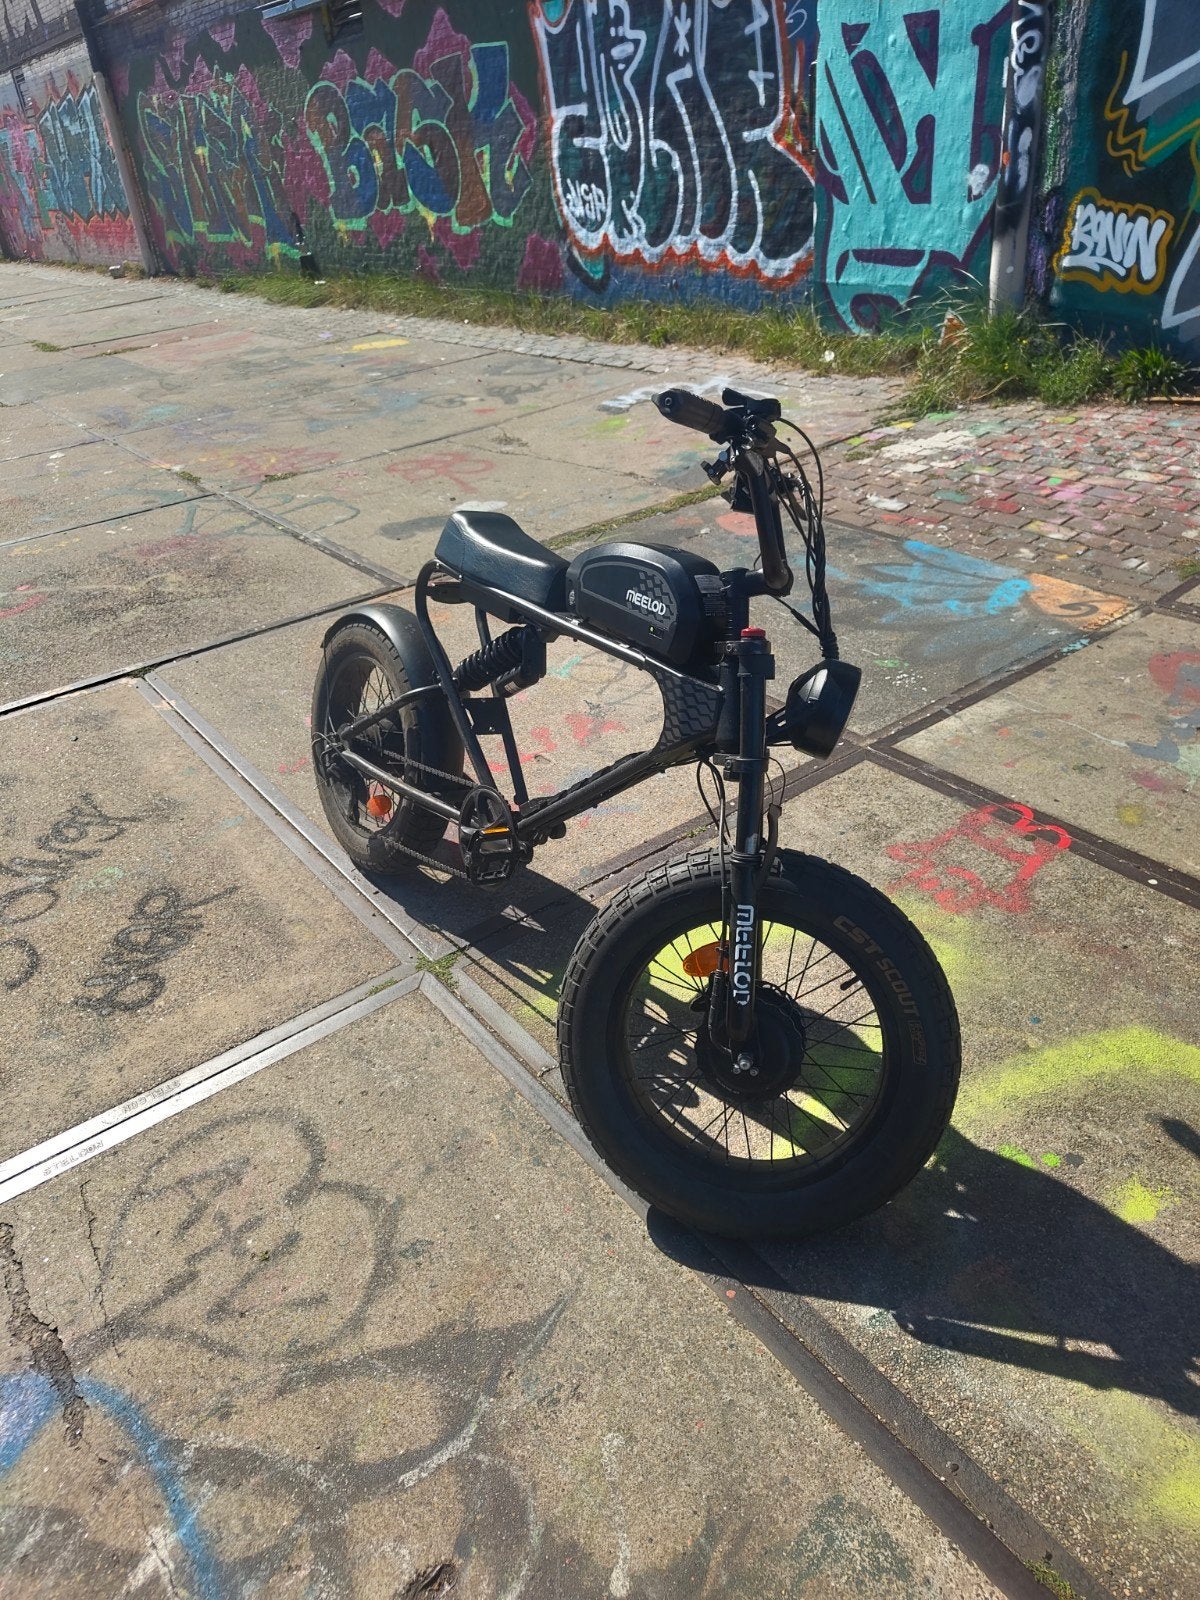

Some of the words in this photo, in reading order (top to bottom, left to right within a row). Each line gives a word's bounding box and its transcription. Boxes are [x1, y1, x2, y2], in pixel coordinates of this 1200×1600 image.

[625, 589, 667, 616] MEELOD
[833, 915, 884, 957] CST
[876, 958, 920, 1016] SCOUT
